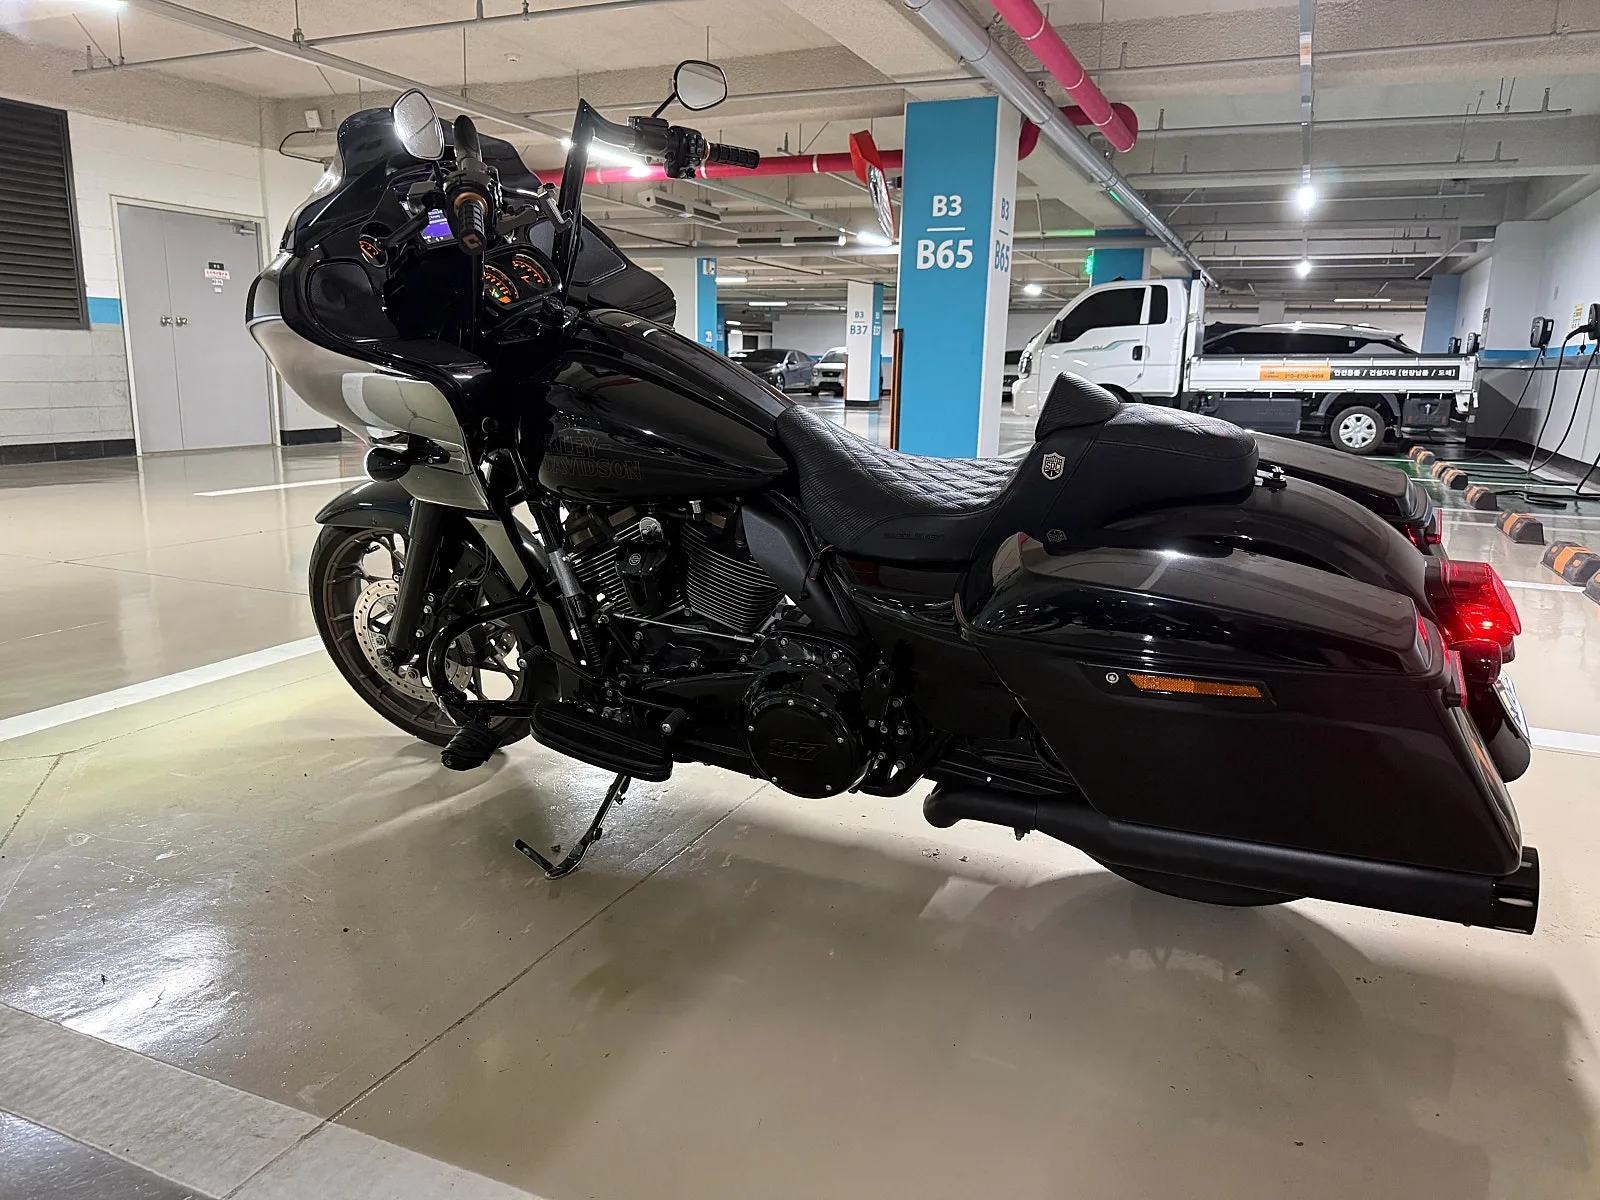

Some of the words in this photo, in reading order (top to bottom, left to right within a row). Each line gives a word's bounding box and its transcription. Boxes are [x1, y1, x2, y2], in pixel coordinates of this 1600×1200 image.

[932, 195, 962, 217] B3
[1001, 198, 1010, 221] B3
[916, 240, 974, 270] B65
[994, 240, 1010, 272] B65
[854, 311, 865, 319] B3
[850, 325, 868, 335] B37
[541, 433, 612, 458] RLEY-
[543, 456, 642, 481] DAVIDSON
